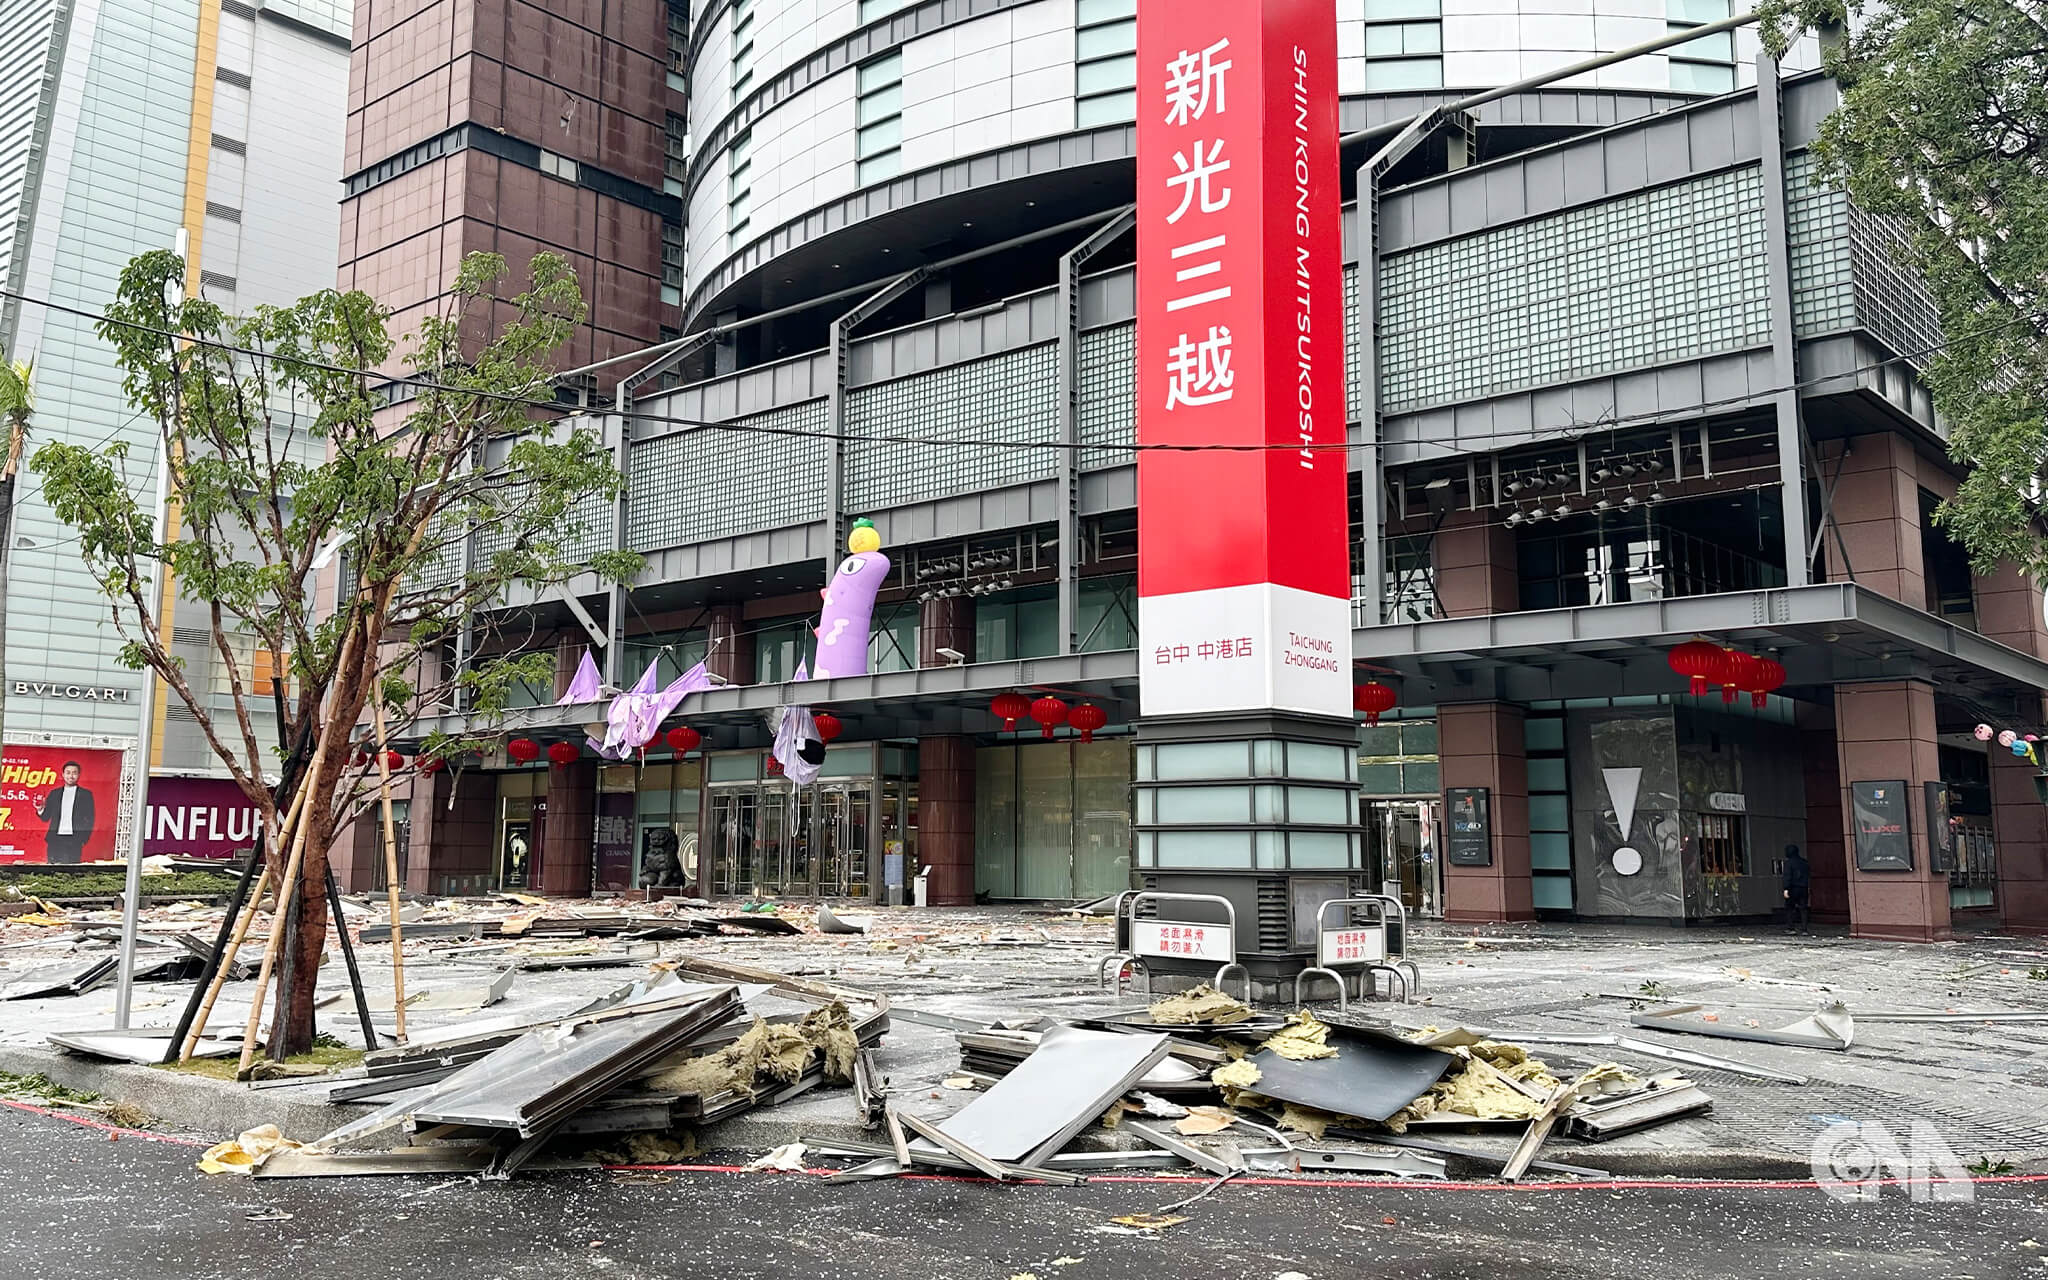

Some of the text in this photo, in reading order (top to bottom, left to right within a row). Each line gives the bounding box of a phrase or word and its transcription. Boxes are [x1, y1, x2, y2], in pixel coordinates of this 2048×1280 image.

[1164, 36, 1235, 412] 新光三越
[1292, 44, 1314, 470] SHIN KONG MITSUKOSHI
[1155, 637, 1253, 666] 台中 中港店
[1289, 632, 1333, 654] TAICHUNG
[1284, 650, 1338, 673] ZHONGGANG
[14, 681, 129, 702] BVLGARI
